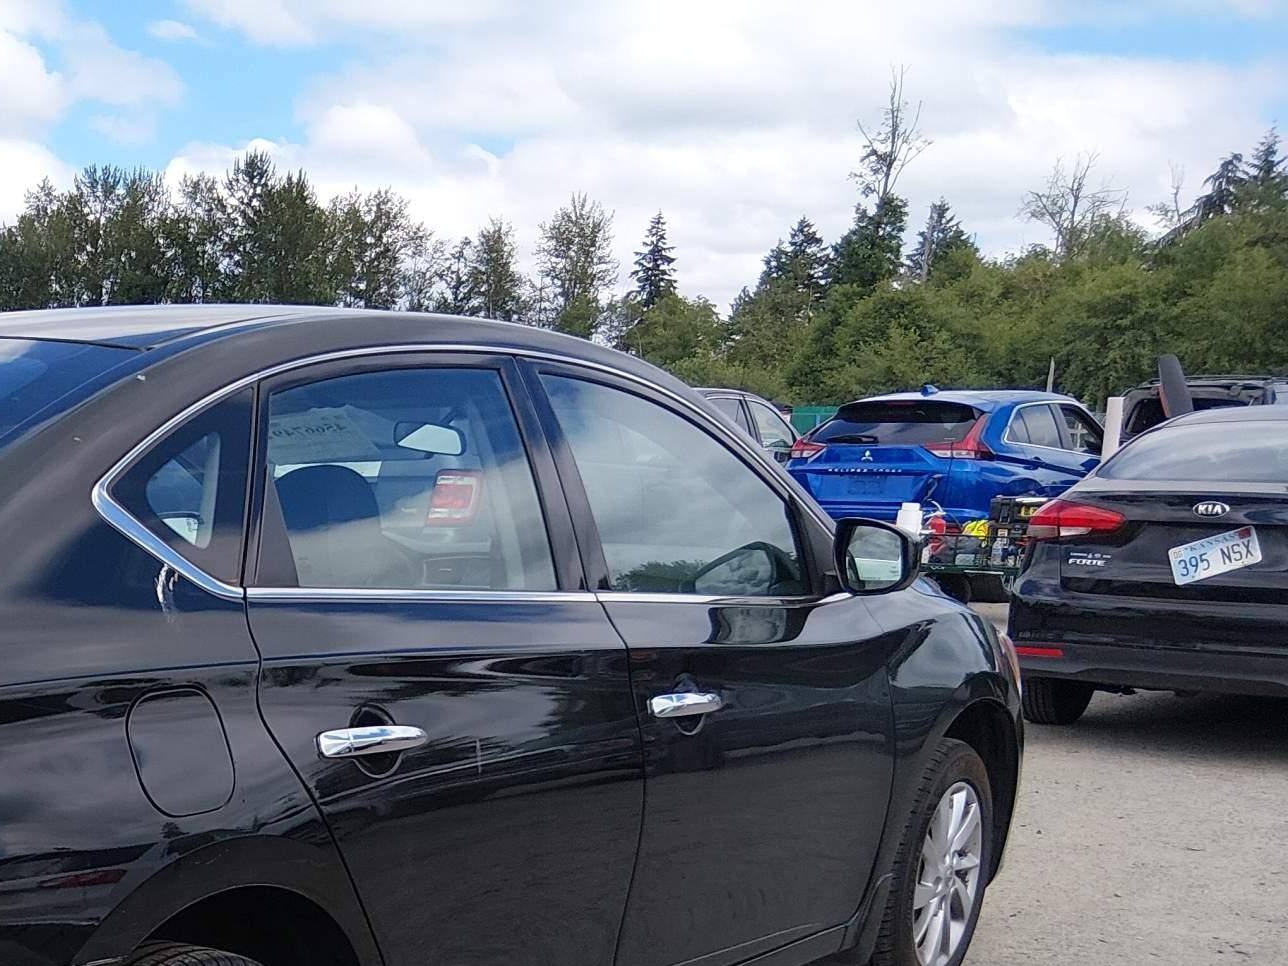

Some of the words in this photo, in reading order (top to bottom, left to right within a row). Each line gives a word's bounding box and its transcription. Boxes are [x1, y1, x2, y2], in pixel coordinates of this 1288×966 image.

[1198, 504, 1222, 515] KIA
[1189, 532, 1236, 552] KANSAS
[1068, 558, 1107, 567] FORTE
[1178, 552, 1211, 577] 395
[1220, 539, 1254, 565] NSX
